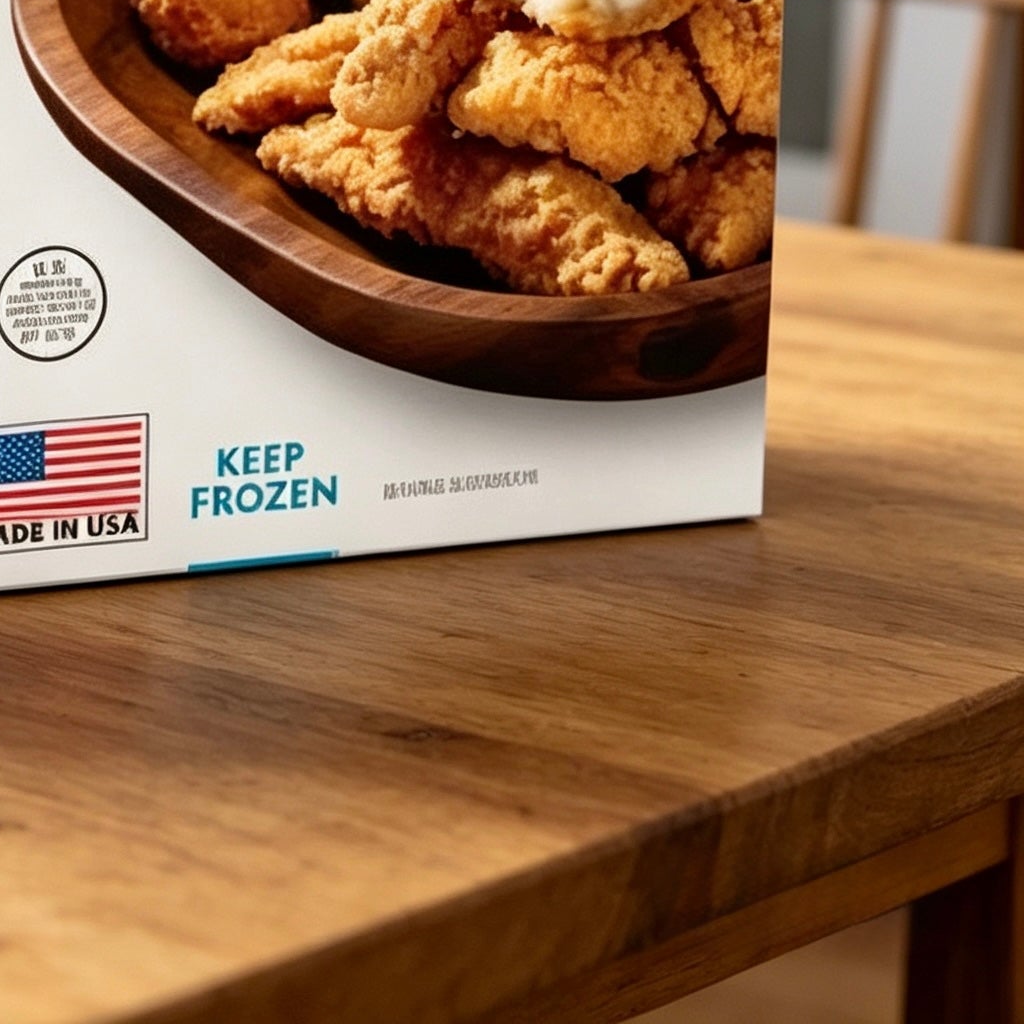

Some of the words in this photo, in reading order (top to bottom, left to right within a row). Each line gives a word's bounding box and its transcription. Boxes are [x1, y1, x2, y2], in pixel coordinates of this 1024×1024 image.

[218, 443, 304, 476] KEEP
[192, 477, 337, 518] FROZEN
[53, 519, 78, 540] IN
[87, 513, 139, 536] USA
